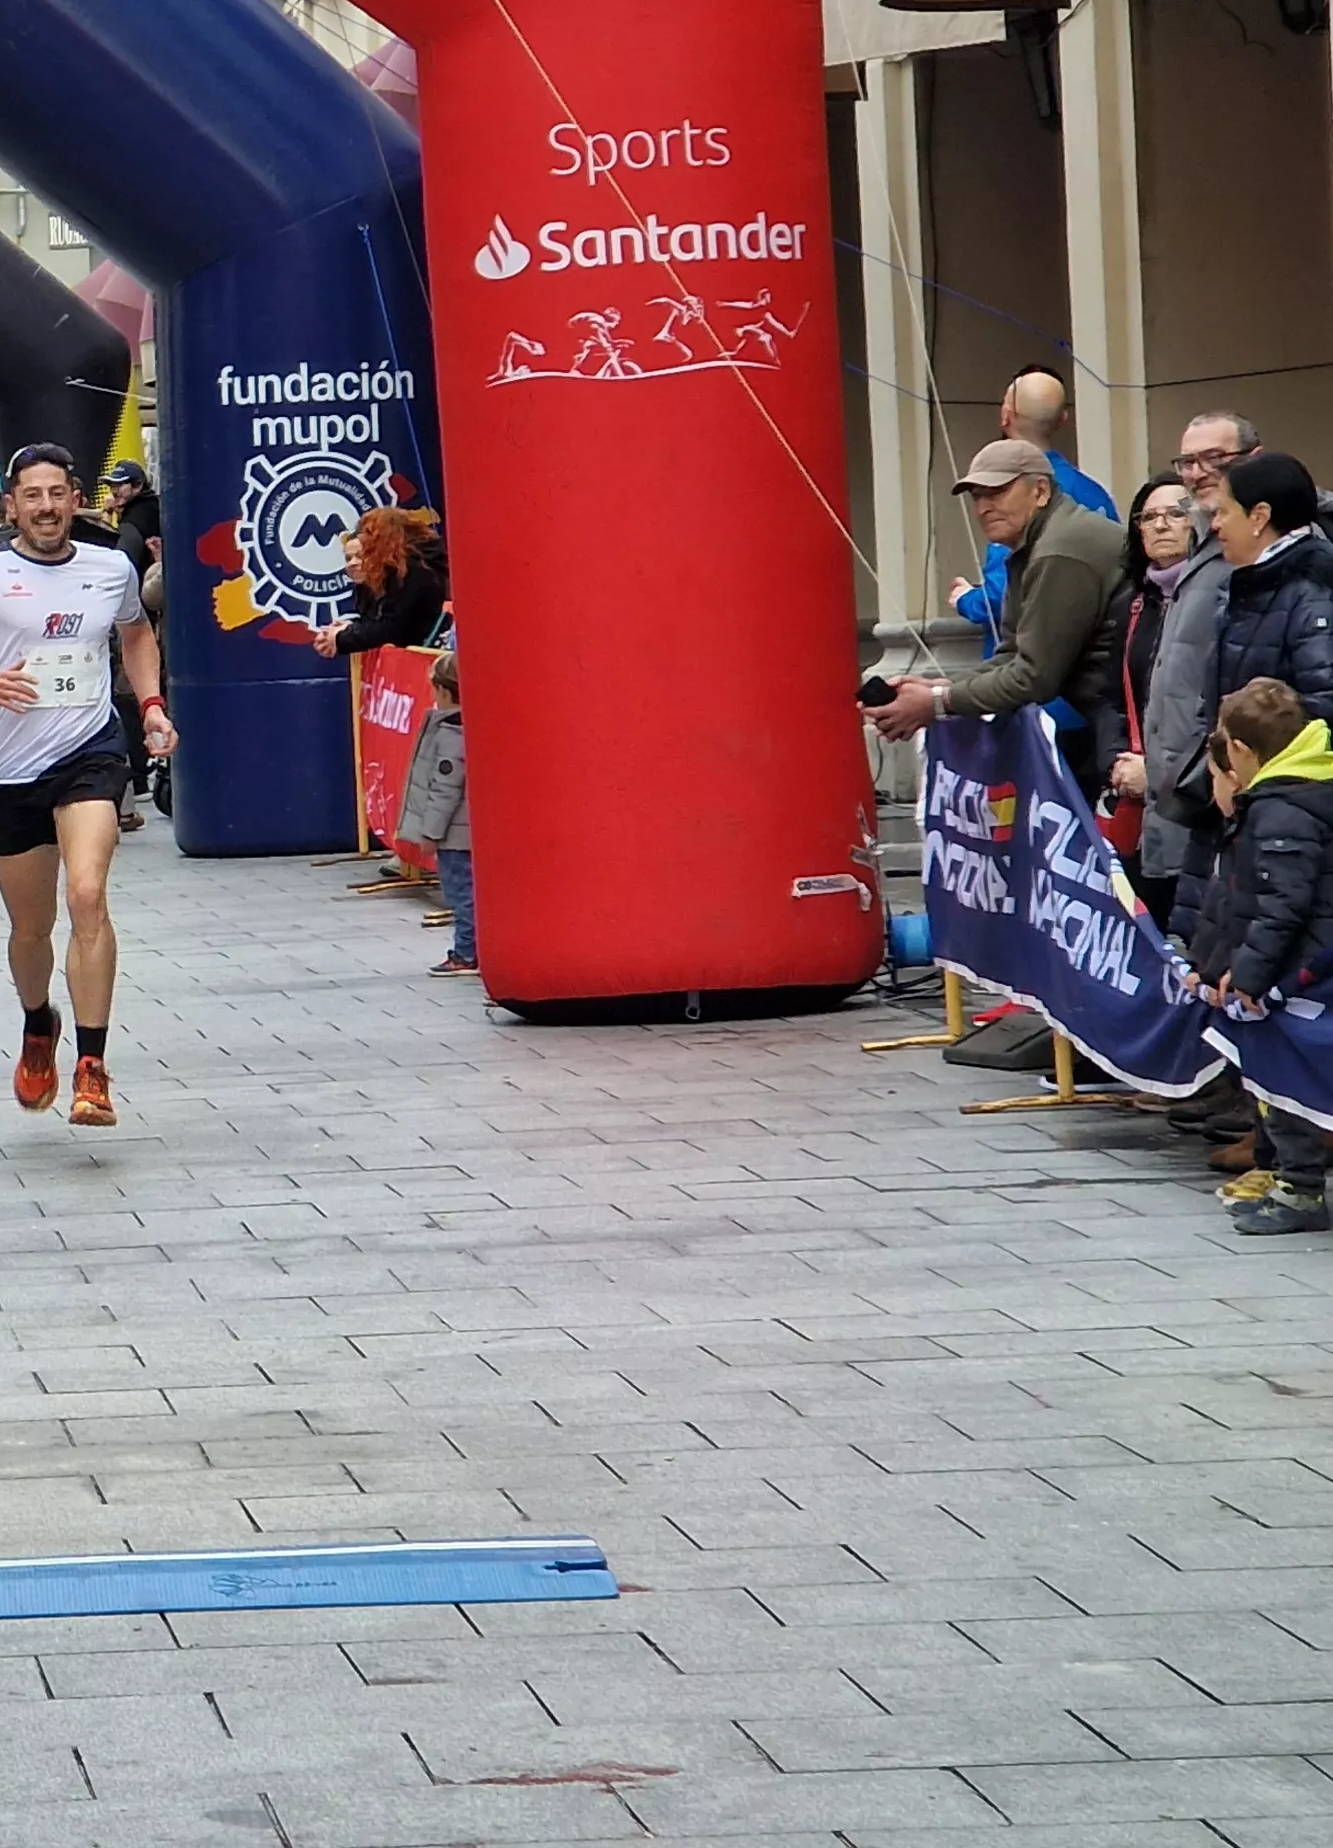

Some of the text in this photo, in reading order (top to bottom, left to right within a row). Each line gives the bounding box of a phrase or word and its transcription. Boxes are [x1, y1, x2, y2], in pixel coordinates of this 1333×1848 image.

[548, 118, 730, 187] Sports
[539, 212, 806, 272] Santander
[217, 359, 415, 406] fundación
[252, 402, 379, 452] mupol
[264, 488, 291, 546] Fundación
[289, 481, 303, 493] de
[304, 475, 316, 487] la
[54, 677, 76, 692] 36
